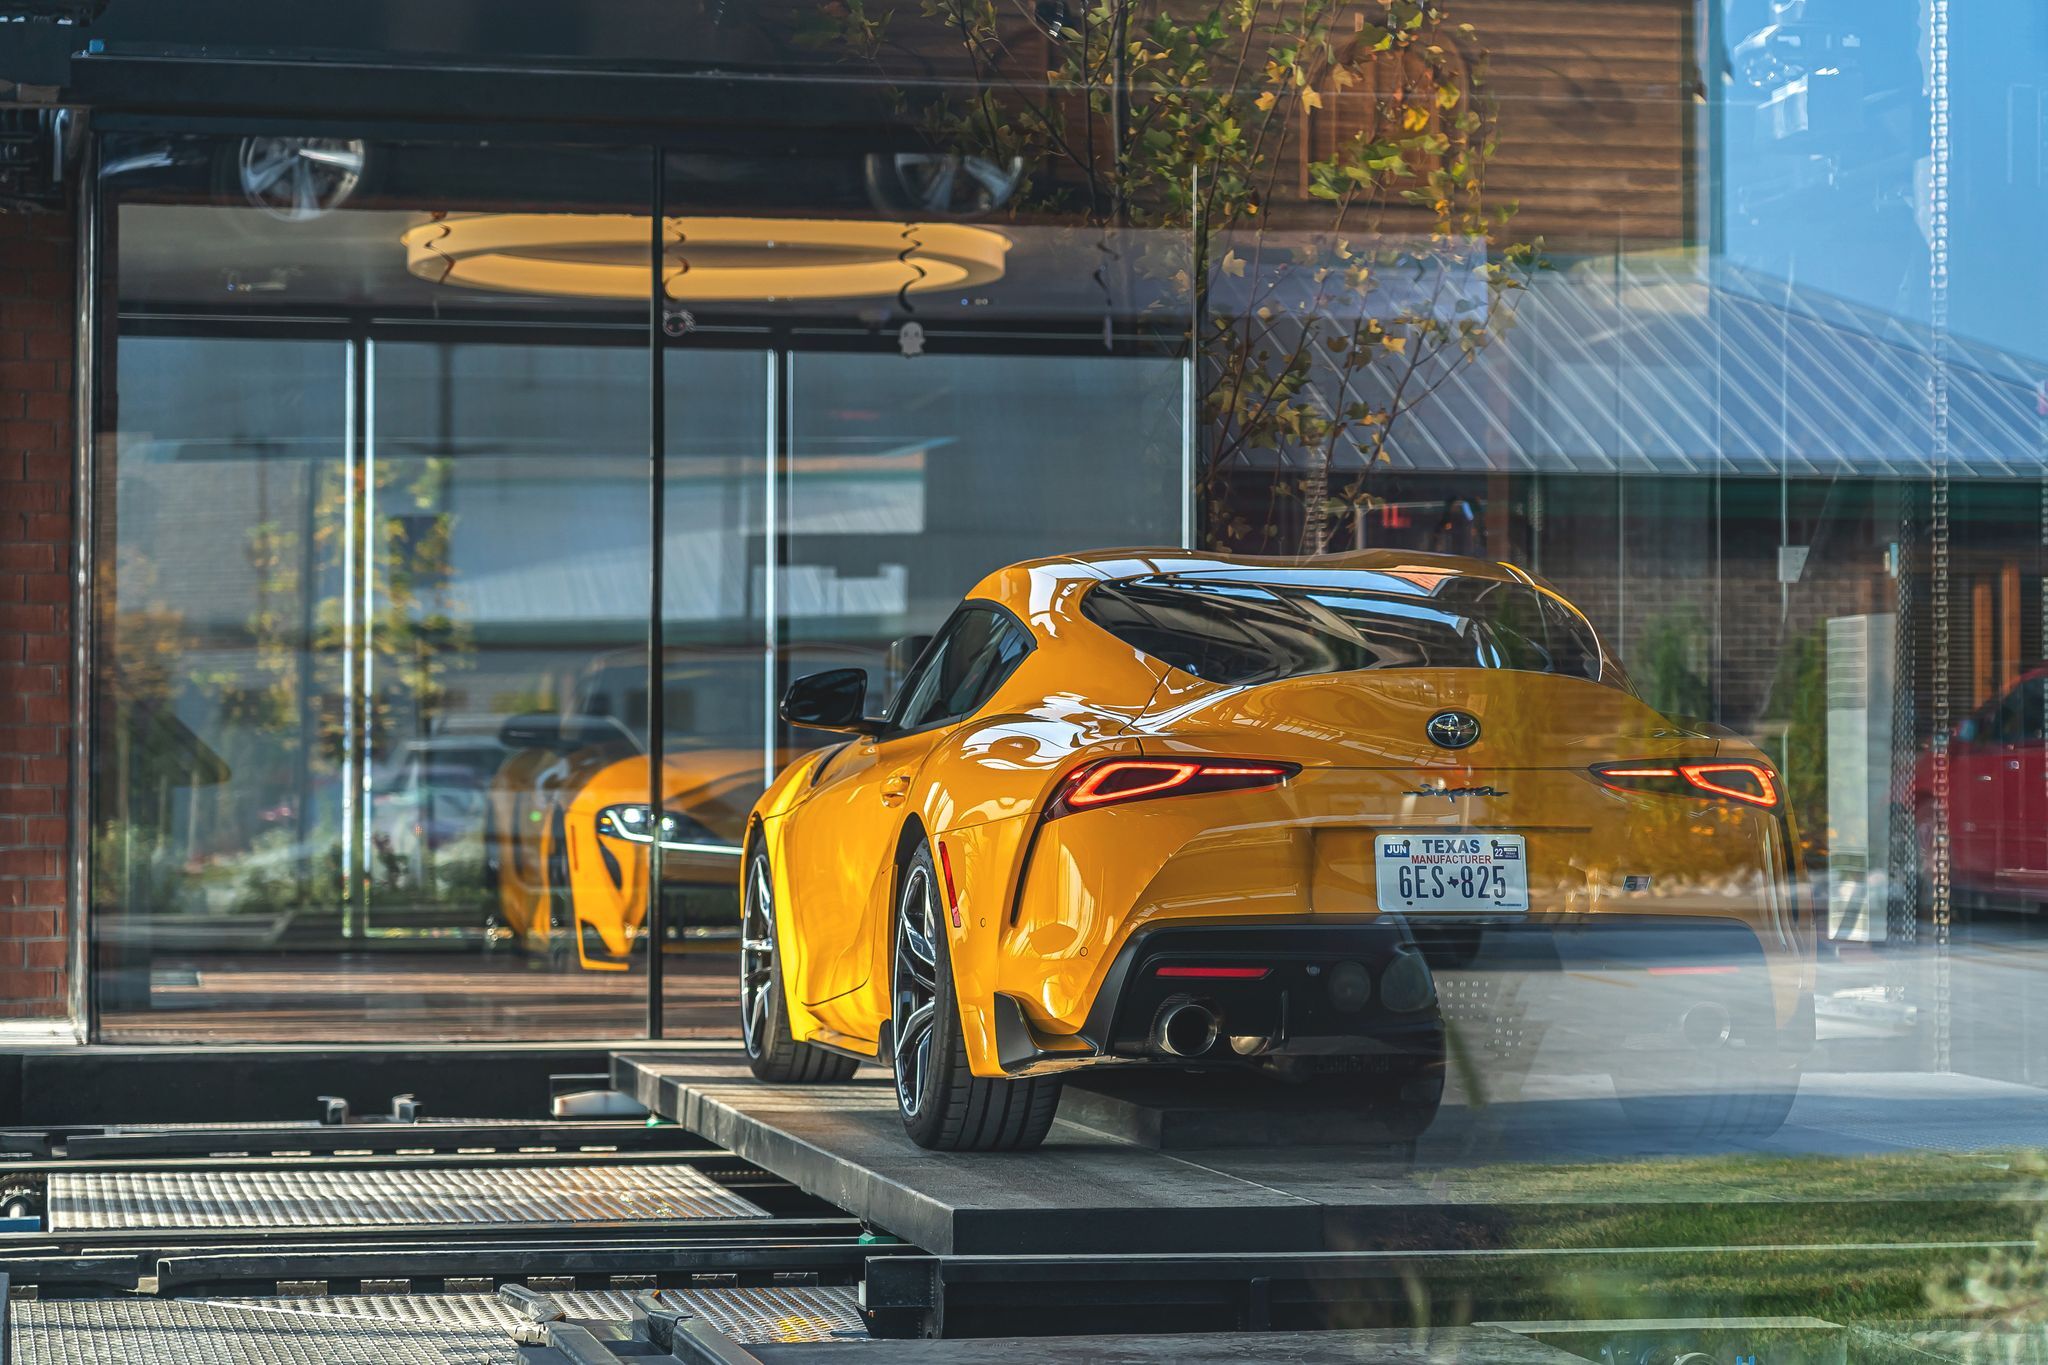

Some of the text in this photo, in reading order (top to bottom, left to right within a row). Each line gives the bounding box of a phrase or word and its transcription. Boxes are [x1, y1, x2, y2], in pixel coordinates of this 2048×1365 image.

[1387, 845, 1407, 854] JUN
[1422, 840, 1480, 853] TEXAS
[1494, 848, 1503, 857] 22
[1411, 855, 1491, 864] MANUFACTURER
